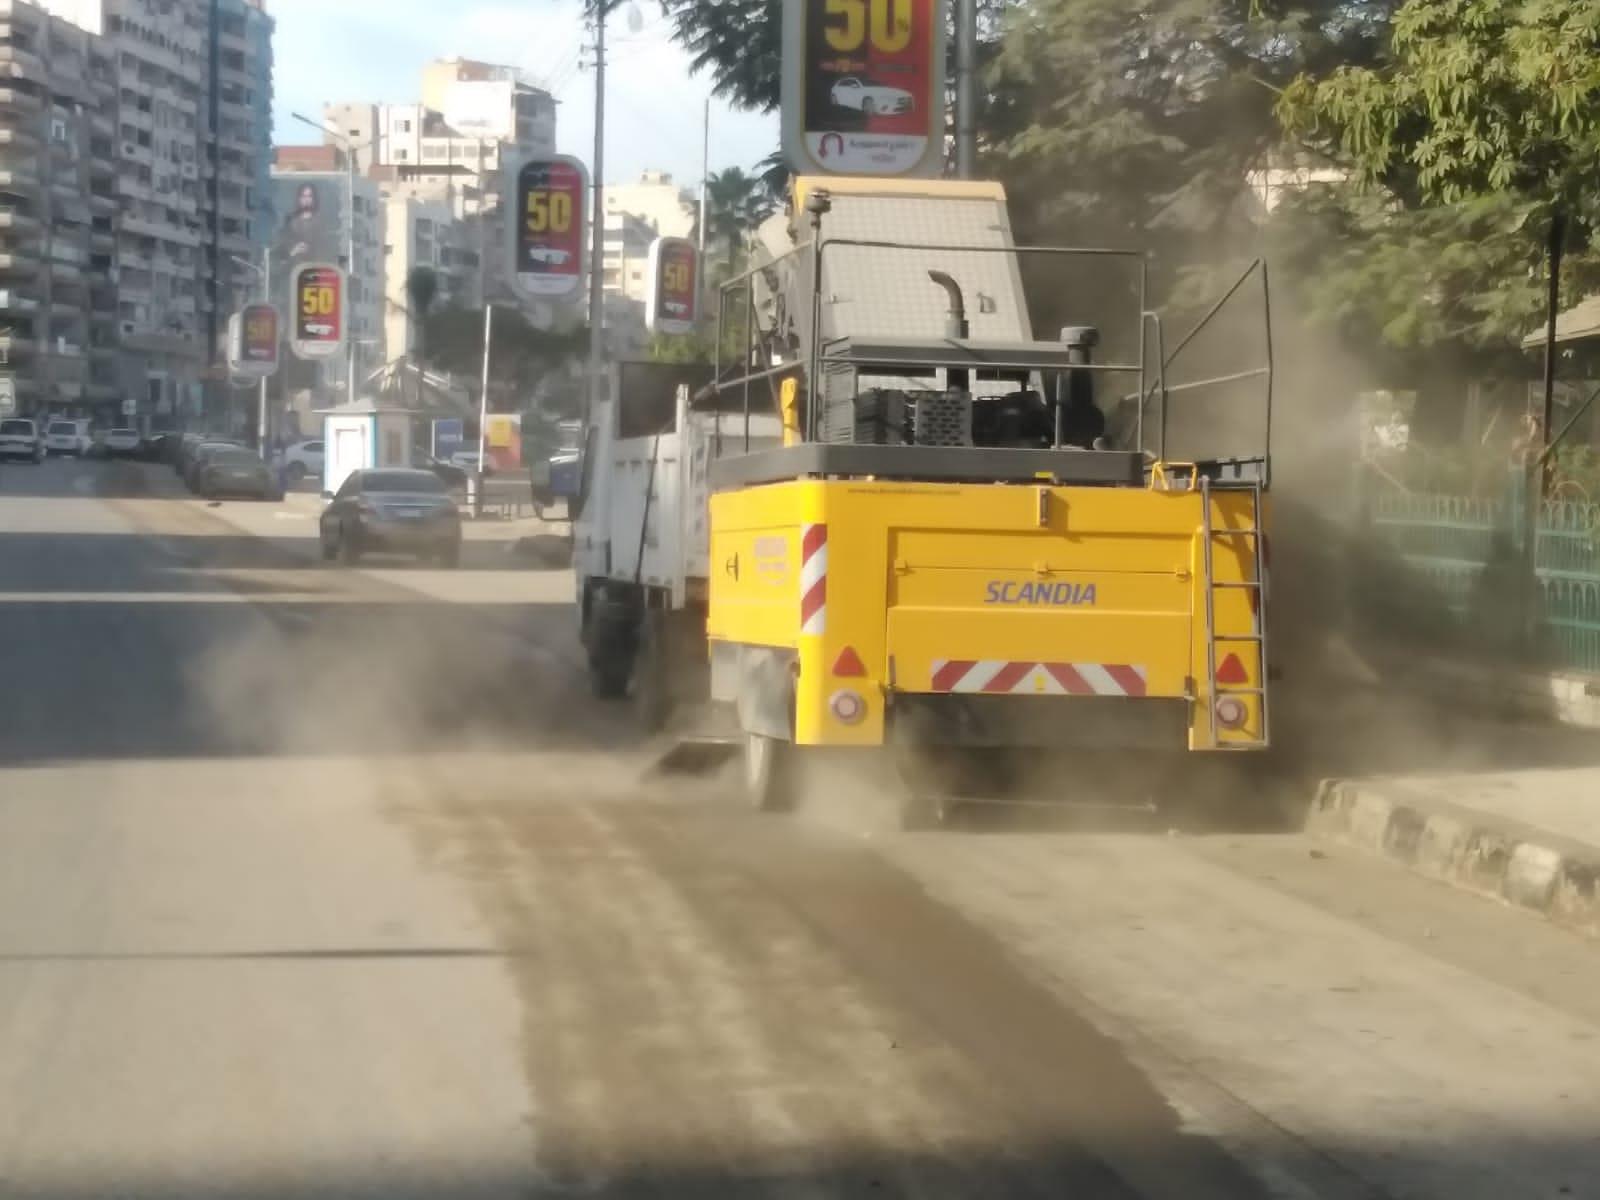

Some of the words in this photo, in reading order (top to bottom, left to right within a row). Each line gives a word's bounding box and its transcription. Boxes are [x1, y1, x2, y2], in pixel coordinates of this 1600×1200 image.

[824, 0, 912, 51] 50
[526, 190, 572, 232] 50
[663, 262, 690, 293] 50
[303, 286, 335, 315] 50
[983, 580, 1097, 606] SCANDIA
